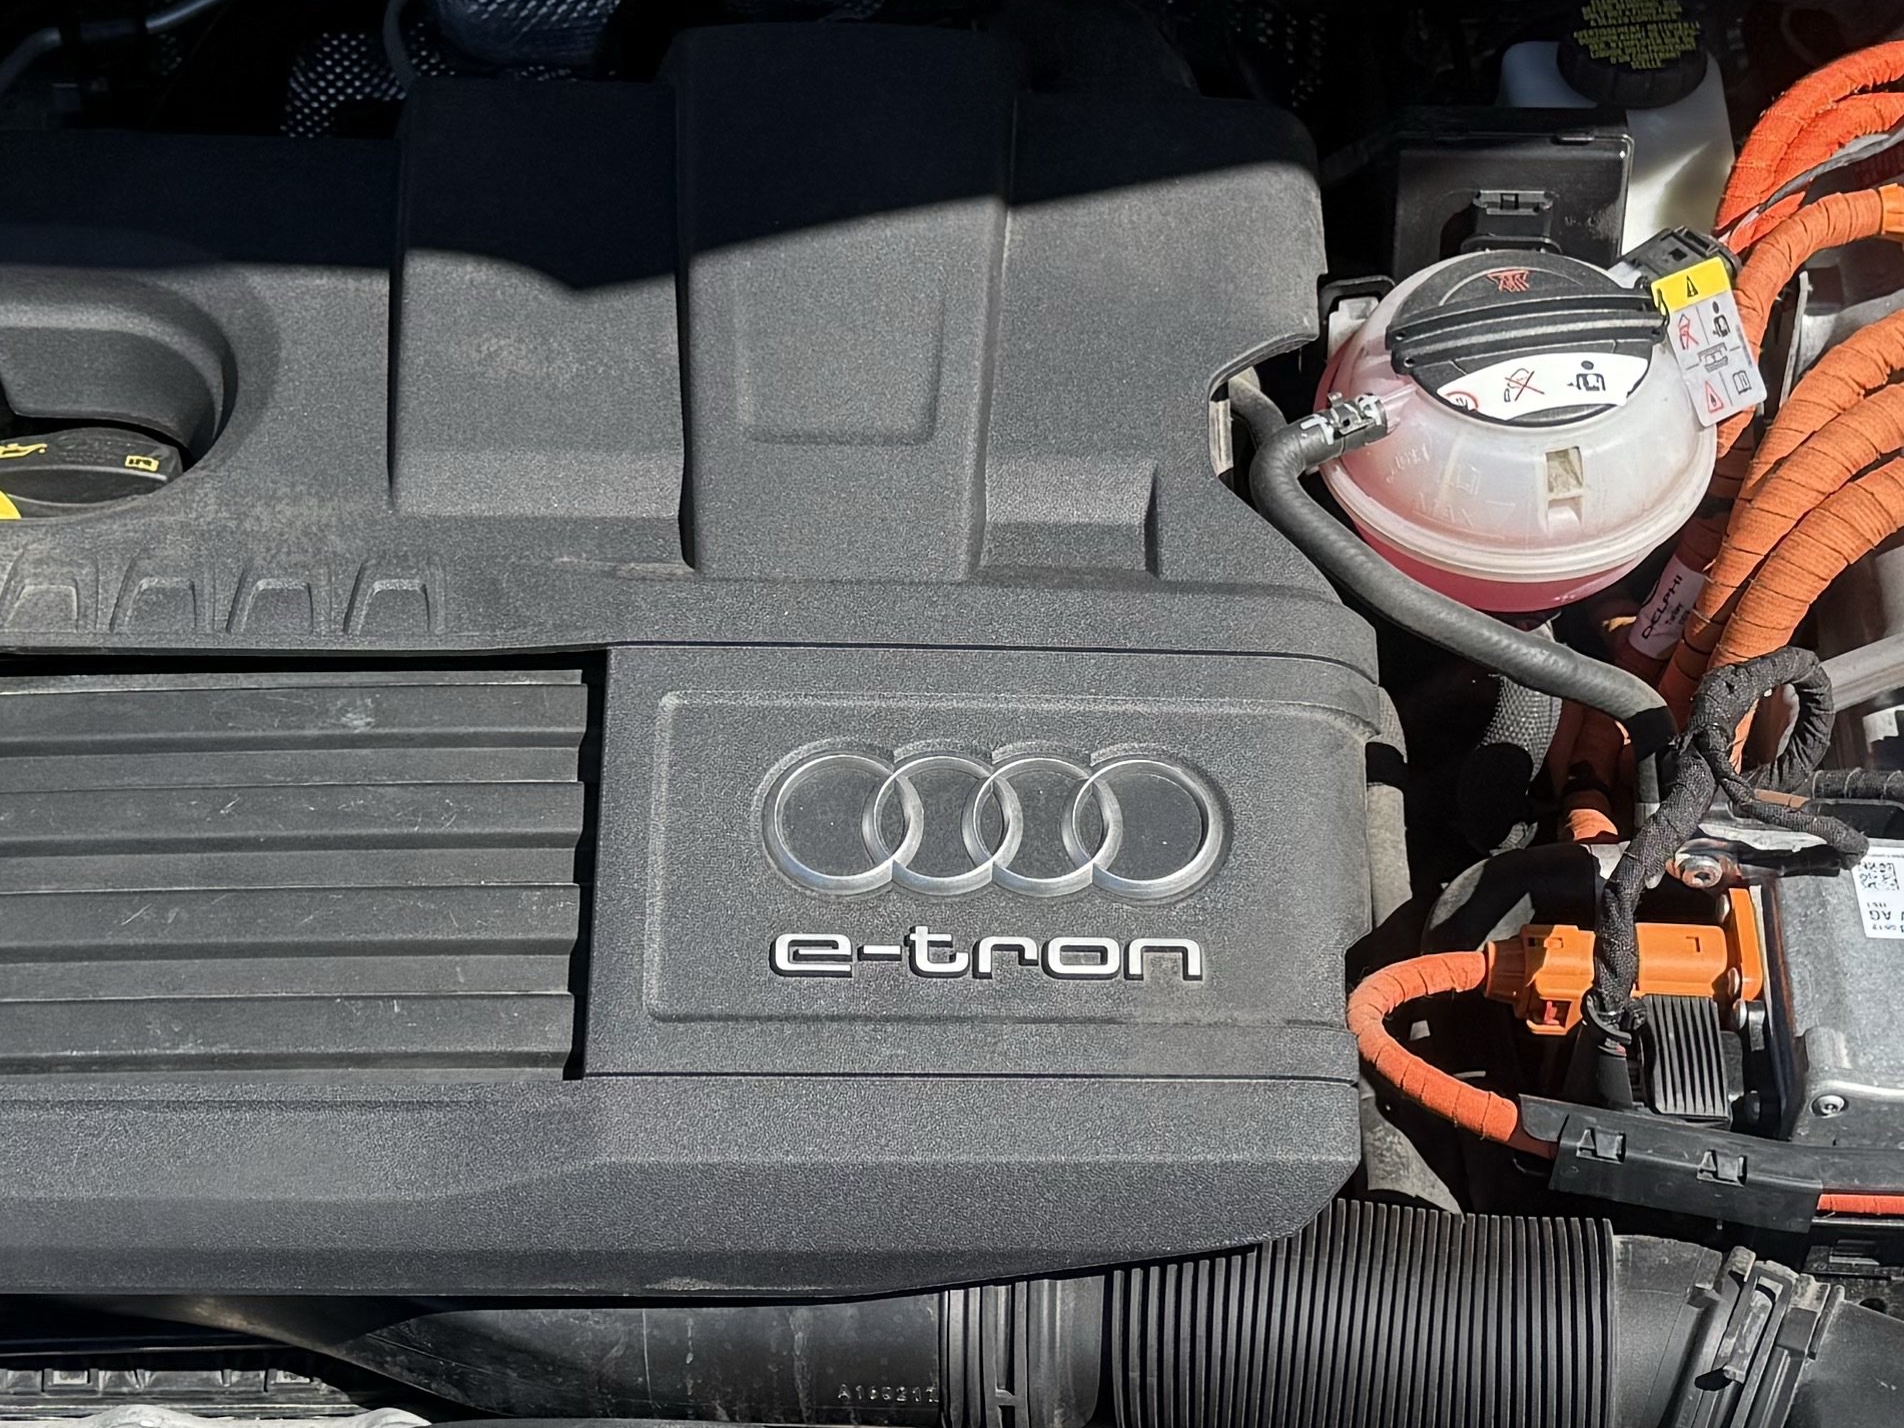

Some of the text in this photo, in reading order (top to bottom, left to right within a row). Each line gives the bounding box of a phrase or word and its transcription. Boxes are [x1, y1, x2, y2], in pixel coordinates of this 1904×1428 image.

[1641, 575, 1682, 639] DELPHI
[1868, 909, 1892, 922] AG
[774, 924, 1202, 980] e-tron
